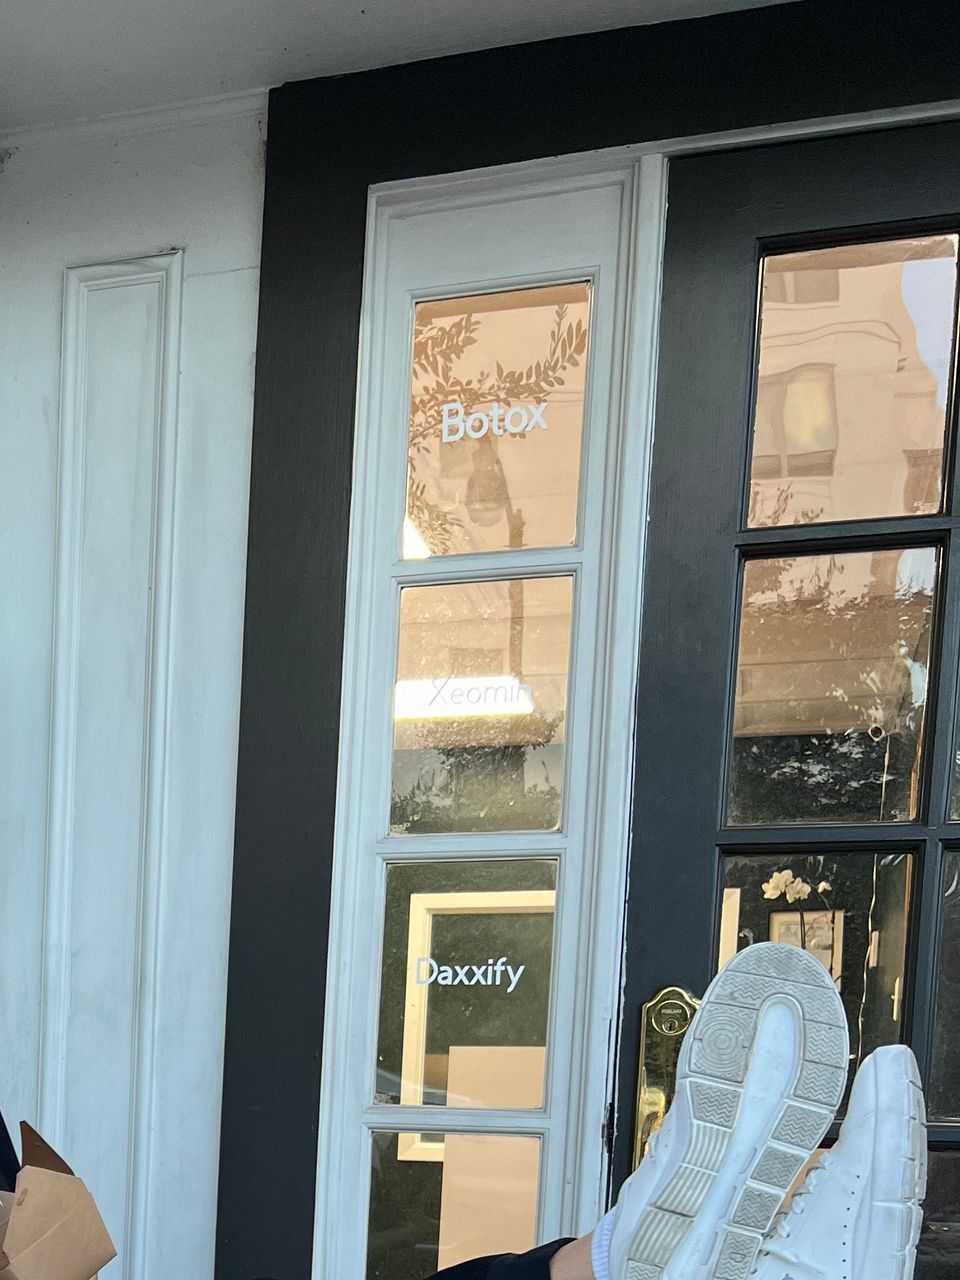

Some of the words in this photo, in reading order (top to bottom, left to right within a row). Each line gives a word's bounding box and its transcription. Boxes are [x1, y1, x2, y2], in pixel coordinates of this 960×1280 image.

[442, 402, 548, 443] Botox
[428, 677, 533, 706] Xeomin
[416, 957, 525, 993] Daxxify
